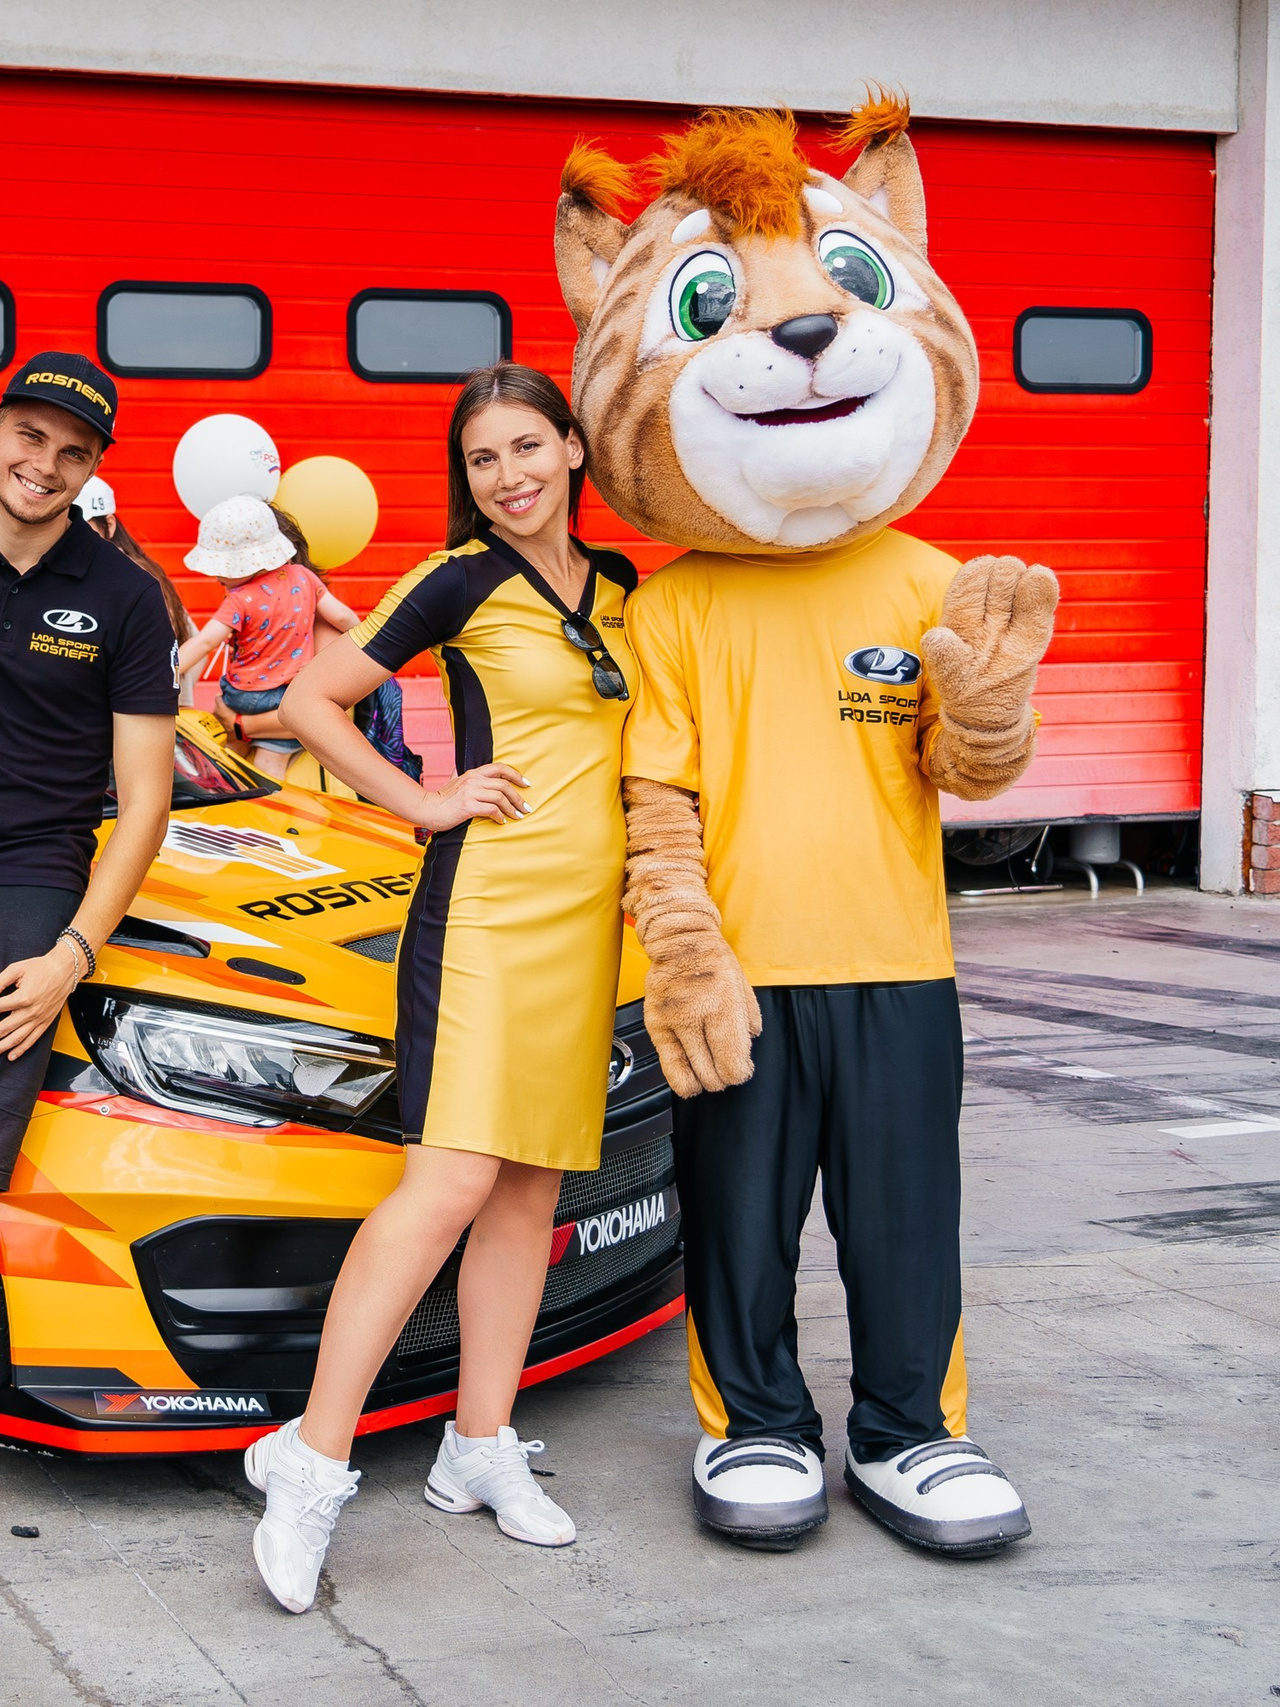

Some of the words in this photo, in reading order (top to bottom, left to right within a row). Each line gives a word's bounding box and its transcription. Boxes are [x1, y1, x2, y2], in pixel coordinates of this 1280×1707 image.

[25, 371, 112, 415] ROSNEFT
[29, 641, 98, 663] ROSNEFT
[31, 632, 55, 644] LADA
[58, 638, 99, 652] SPORT
[838, 690, 872, 703] LADA
[879, 694, 918, 708] SPOR
[236, 871, 416, 922] ROSNE
[576, 1192, 666, 1255] YOKOHAMA
[140, 1395, 264, 1412] YOKOHAMA
